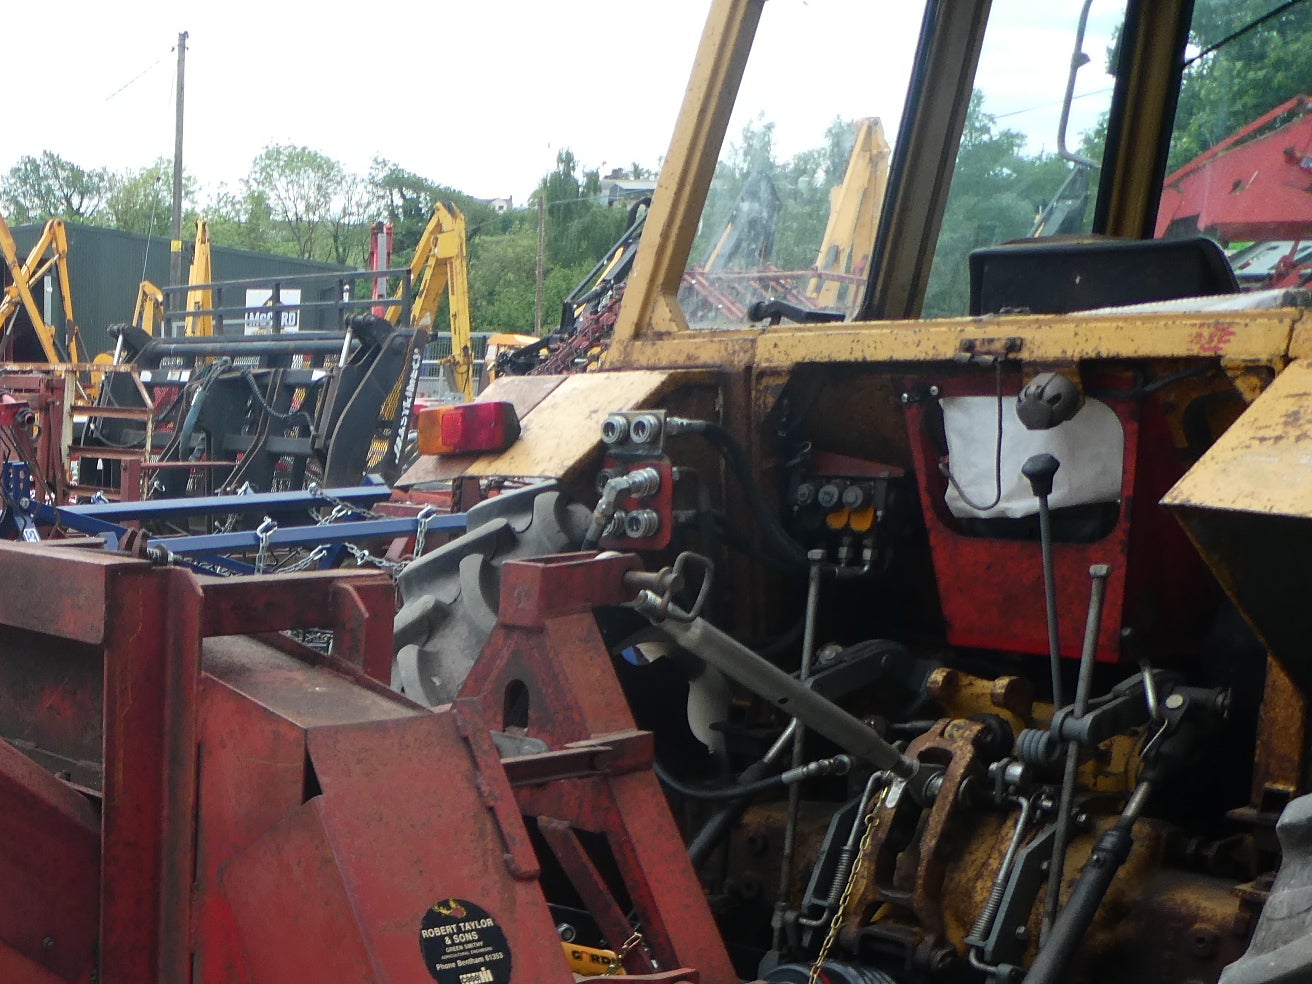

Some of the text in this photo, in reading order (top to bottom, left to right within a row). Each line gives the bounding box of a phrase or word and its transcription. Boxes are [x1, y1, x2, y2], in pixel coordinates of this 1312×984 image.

[249, 310, 296, 327] McCRD
[421, 918, 494, 939] ROBERT TAYLOR
[444, 931, 479, 945] & SONS
[445, 944, 464, 953] GREEN
[435, 961, 456, 971] Phone
